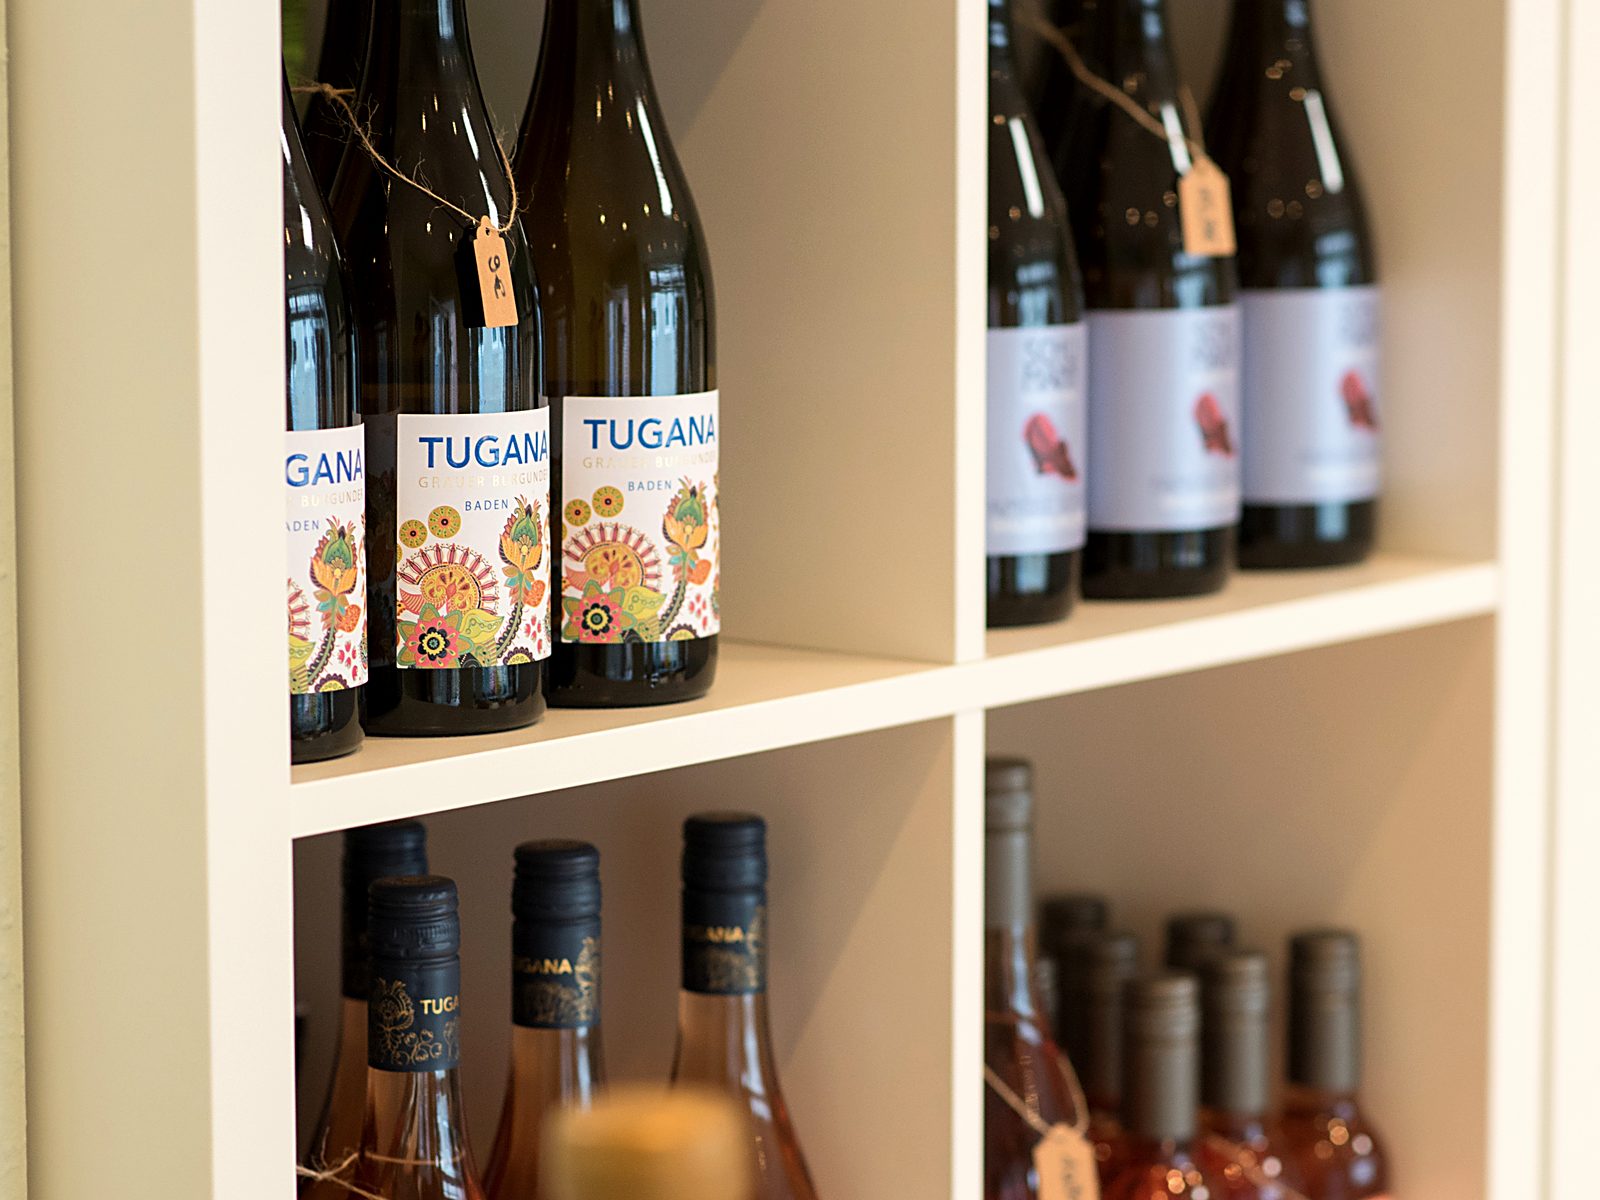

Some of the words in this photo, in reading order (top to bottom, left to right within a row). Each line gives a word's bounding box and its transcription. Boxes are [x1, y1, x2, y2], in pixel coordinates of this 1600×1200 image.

[583, 413, 716, 450] TUGANA
[418, 429, 548, 469] TUGANA
[286, 447, 363, 488] GANA
[492, 468, 548, 488] BURGUNDE
[628, 479, 672, 492] BADEN
[465, 498, 509, 511] BADEN
[286, 519, 320, 532] ADEN
[420, 994, 459, 1015] TUGA
